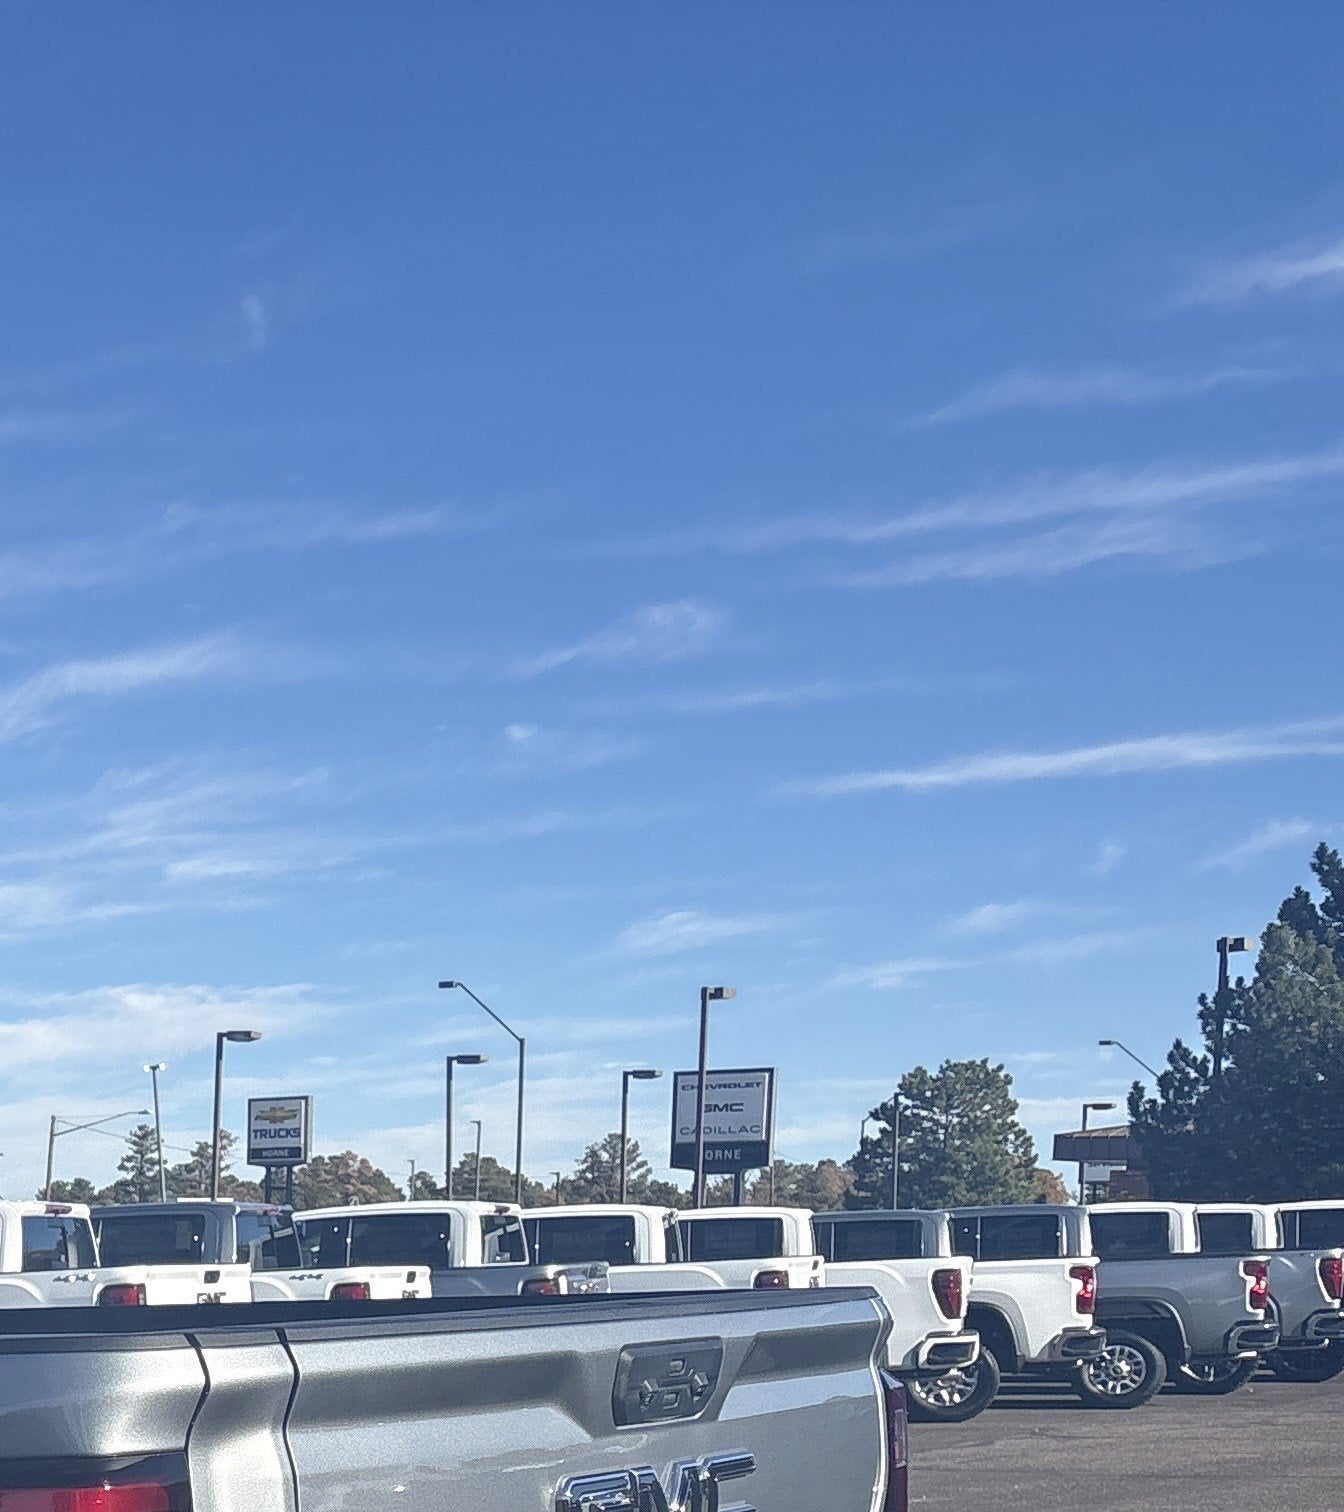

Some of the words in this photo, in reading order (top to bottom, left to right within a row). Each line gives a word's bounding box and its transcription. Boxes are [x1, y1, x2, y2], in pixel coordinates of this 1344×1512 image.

[681, 1081, 763, 1091] CHVROLET
[252, 1127, 301, 1139] TRUCKS
[703, 1148, 742, 1161] ORNE
